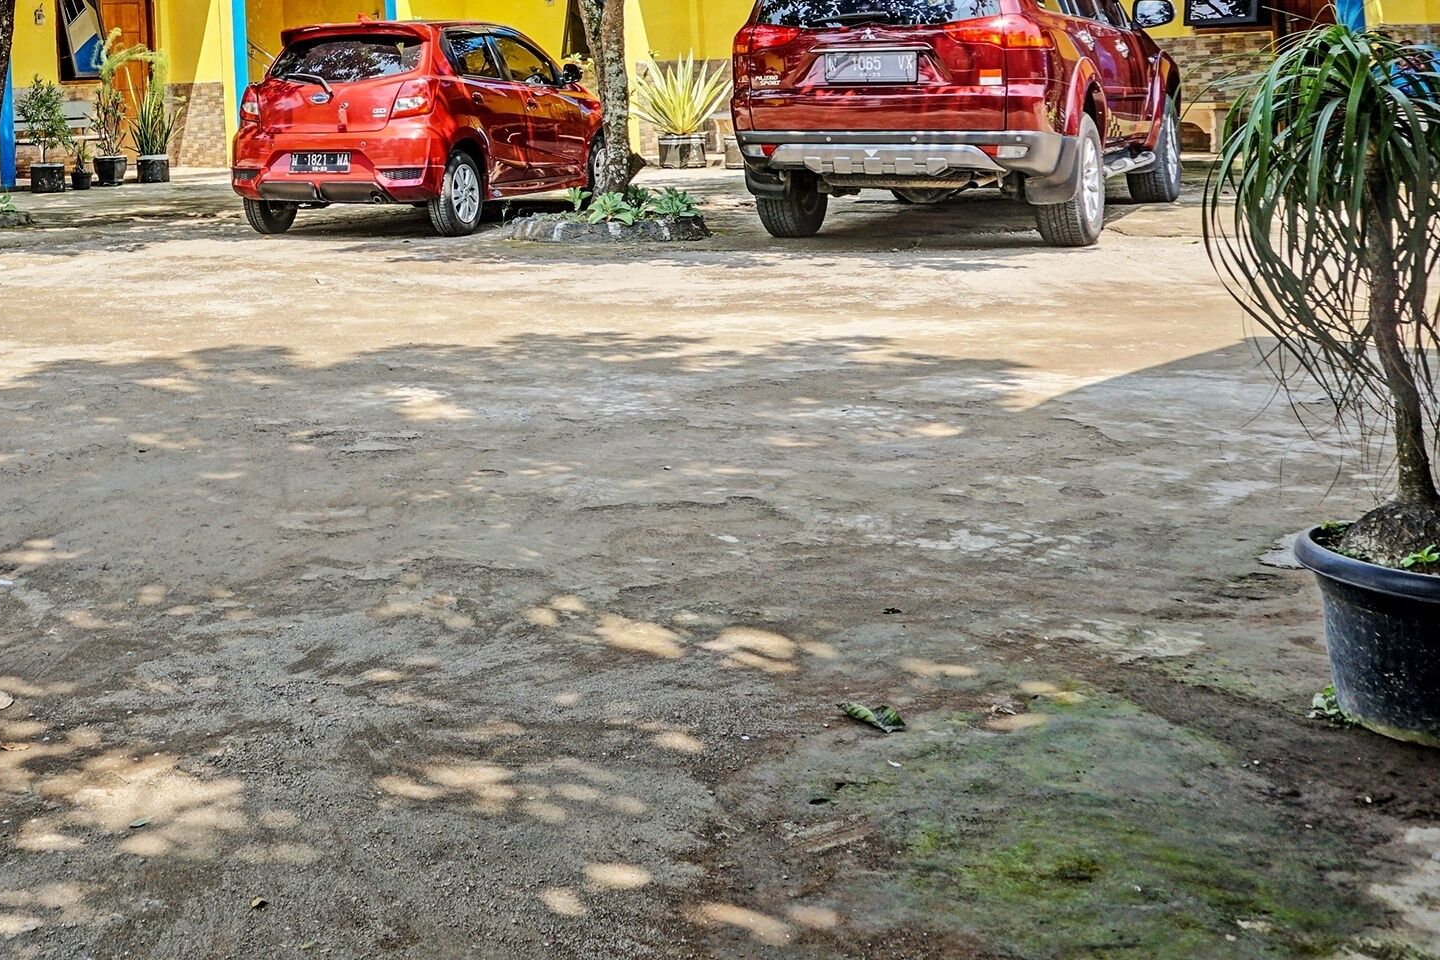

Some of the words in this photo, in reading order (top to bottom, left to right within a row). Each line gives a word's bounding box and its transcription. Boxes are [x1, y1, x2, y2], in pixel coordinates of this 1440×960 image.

[852, 56, 881, 71] 1065
[897, 54, 913, 70] VX
[307, 154, 327, 166] 1821
[337, 154, 349, 166] WA
